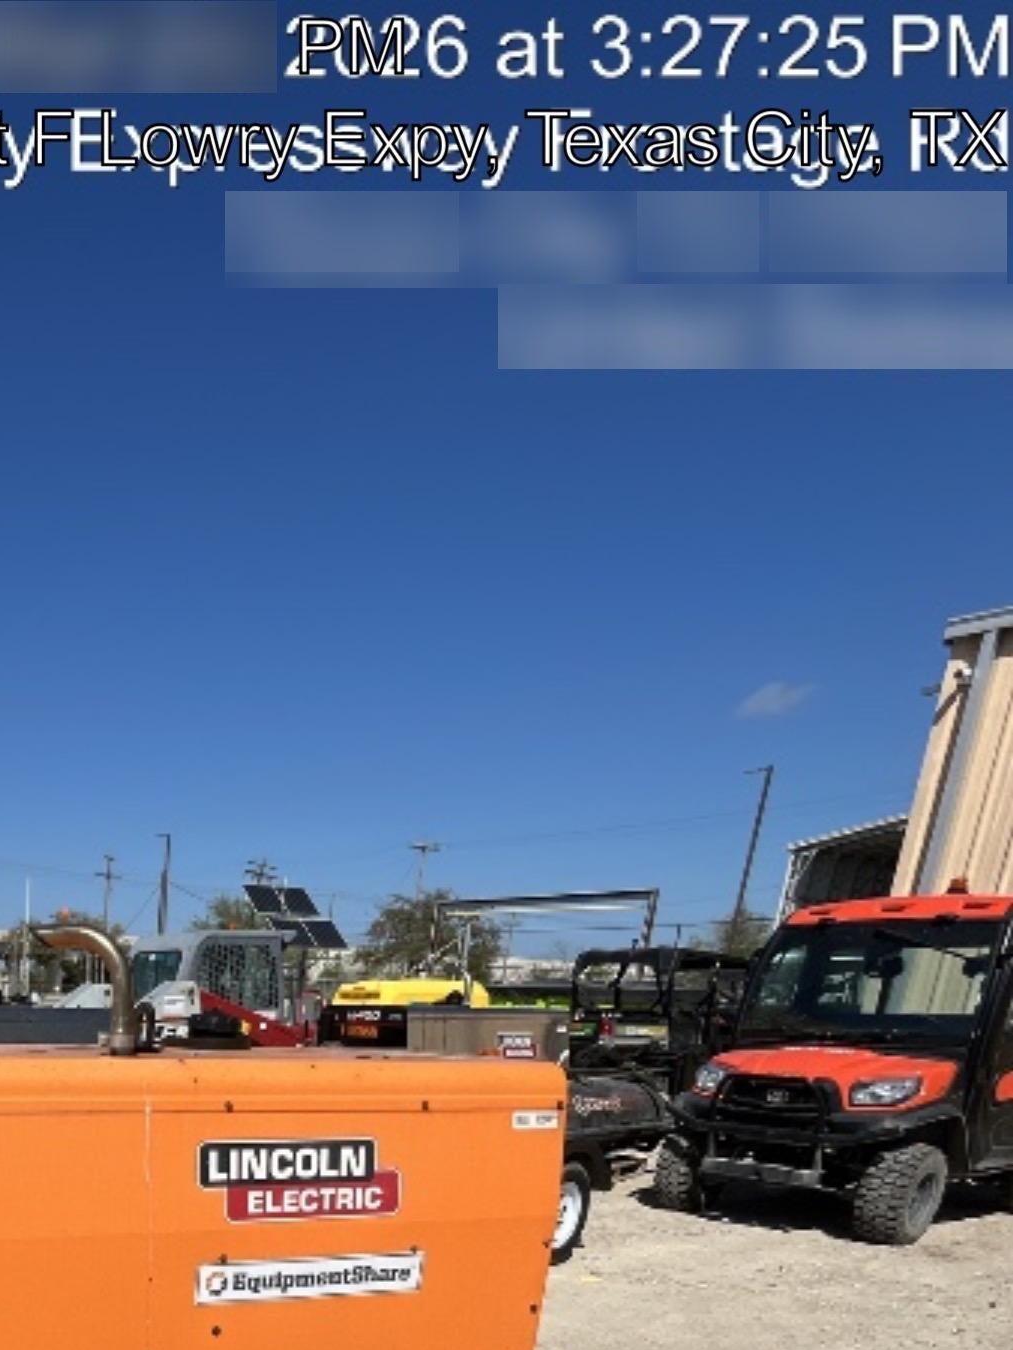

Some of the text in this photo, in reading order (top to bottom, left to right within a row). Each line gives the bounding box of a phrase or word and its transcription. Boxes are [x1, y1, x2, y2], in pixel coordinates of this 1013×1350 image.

[206, 1145, 367, 1183] LINCOLN
[246, 1186, 384, 1214] ELECTRIC
[232, 1265, 411, 1294] EquipmentShare
